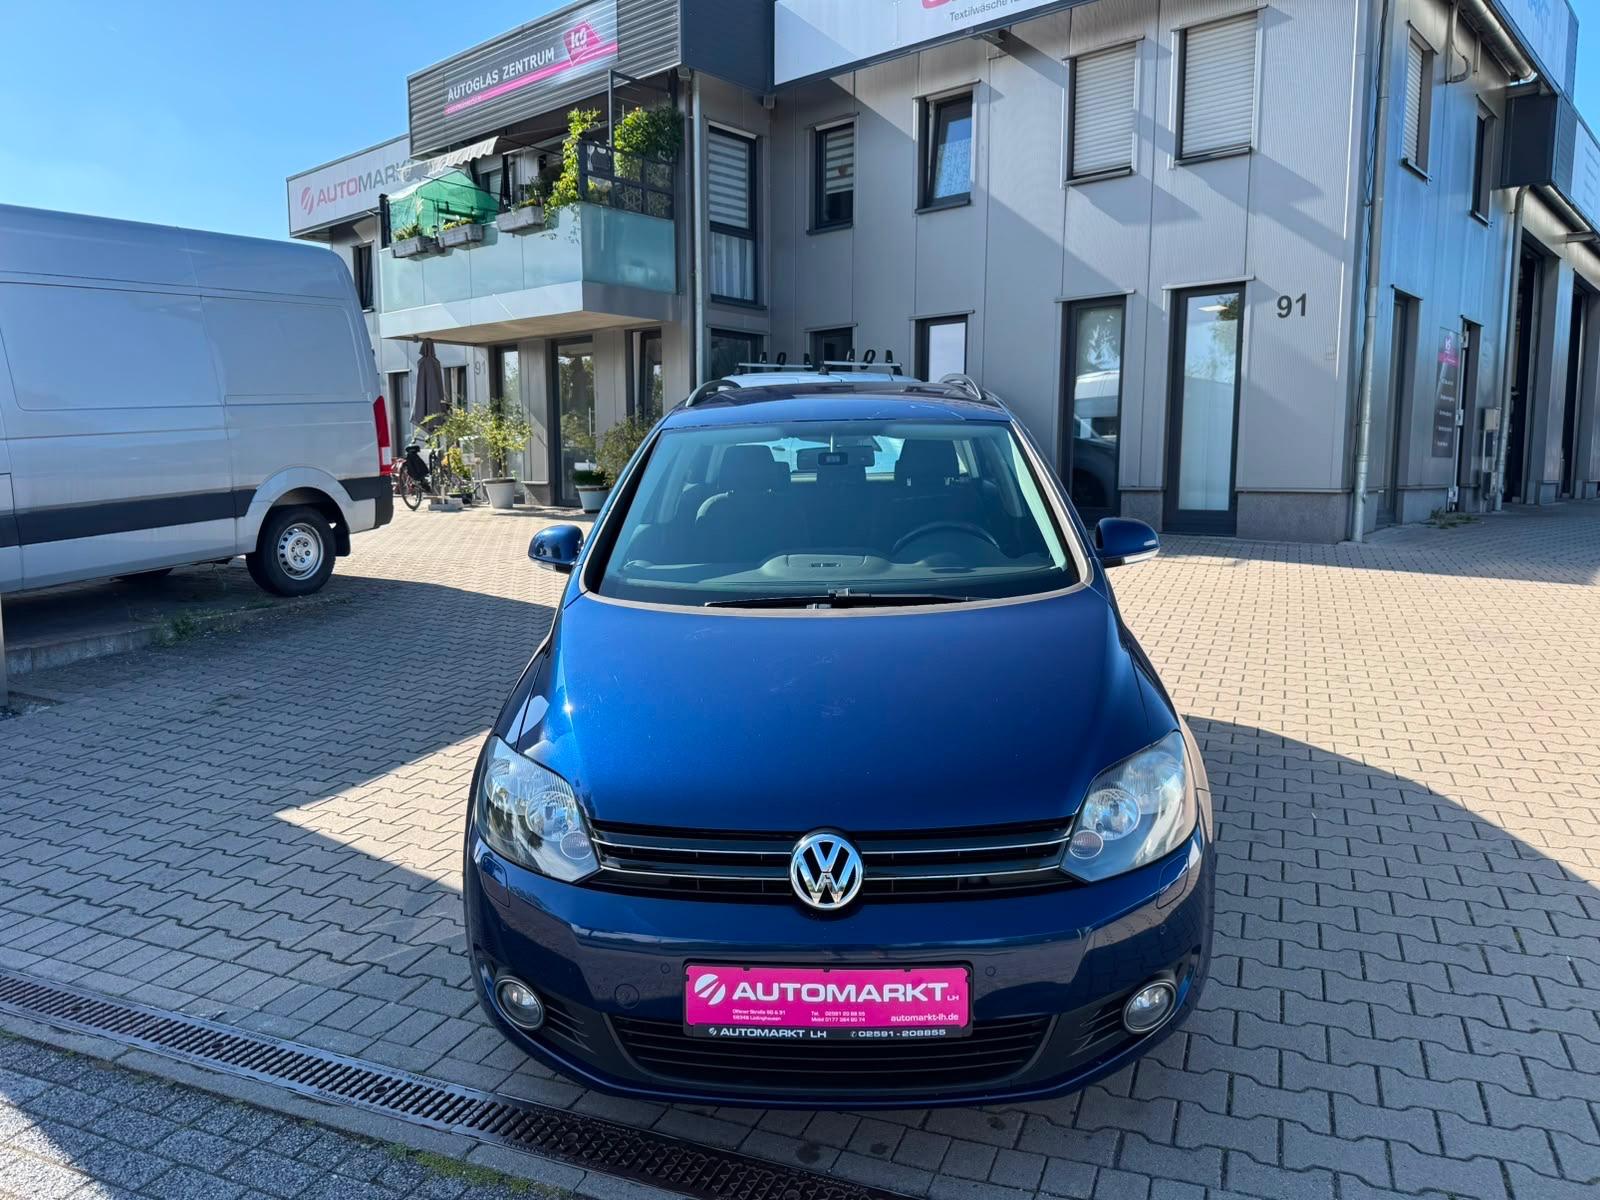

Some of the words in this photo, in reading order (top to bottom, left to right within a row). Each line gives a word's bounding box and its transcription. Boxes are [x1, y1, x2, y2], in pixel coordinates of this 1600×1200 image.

[447, 70, 500, 103] AUTOGLAS
[502, 47, 556, 81] ZENTRUM
[1276, 293, 1307, 319] 91
[474, 359, 487, 376] 91
[731, 981, 949, 1003] AUTOMARKT
[946, 994, 960, 1002] LH
[890, 1012, 960, 1023] automarkt-lh.de
[719, 1027, 806, 1039] AUTOMARKT
[810, 1029, 827, 1039] LH
